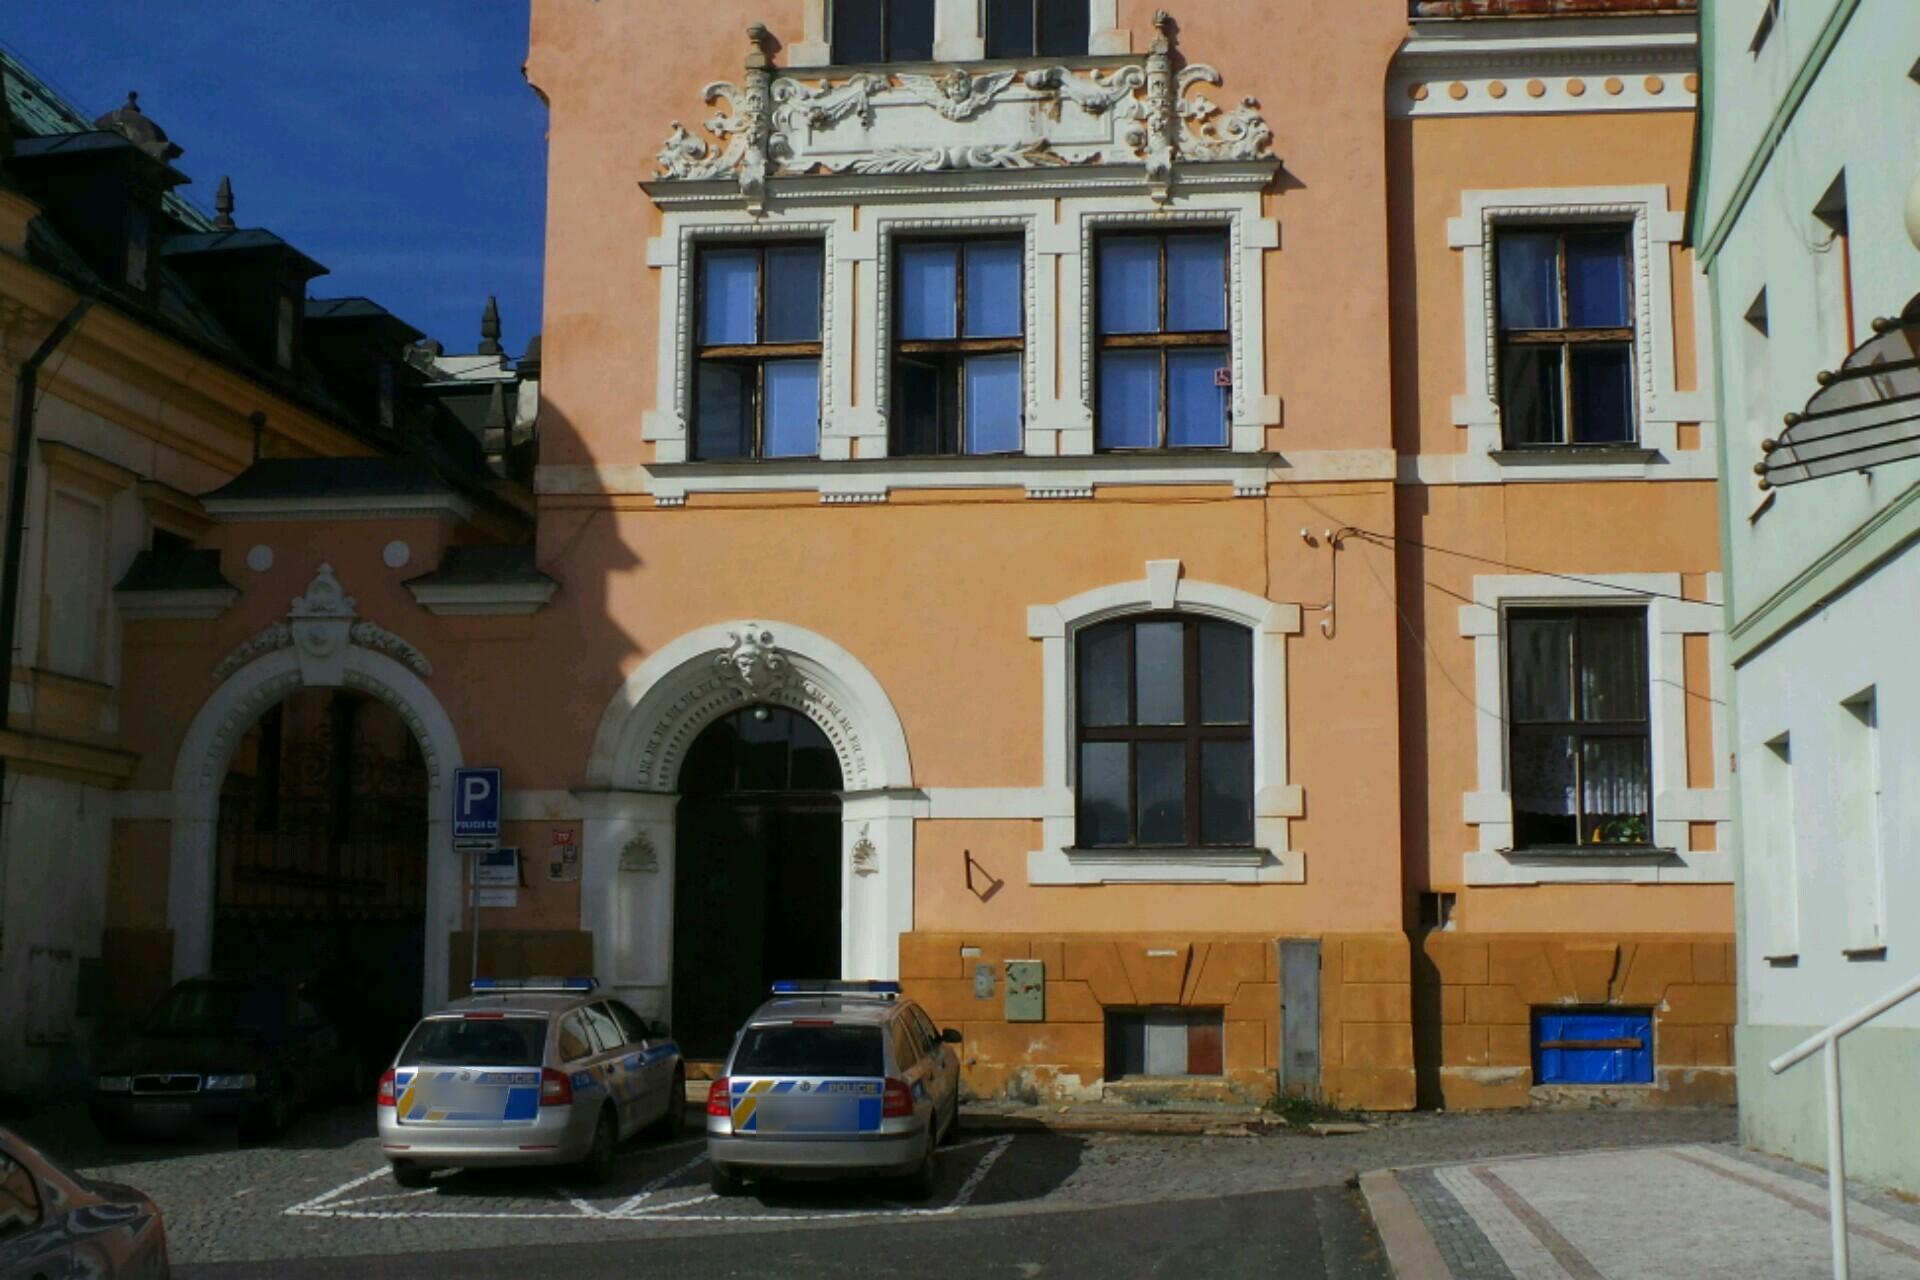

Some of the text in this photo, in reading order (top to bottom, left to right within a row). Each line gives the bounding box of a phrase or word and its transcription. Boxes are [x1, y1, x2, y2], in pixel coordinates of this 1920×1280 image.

[464, 777, 491, 815] P
[487, 1073, 535, 1084] POLICIE
[828, 1081, 877, 1093] POLICIE
